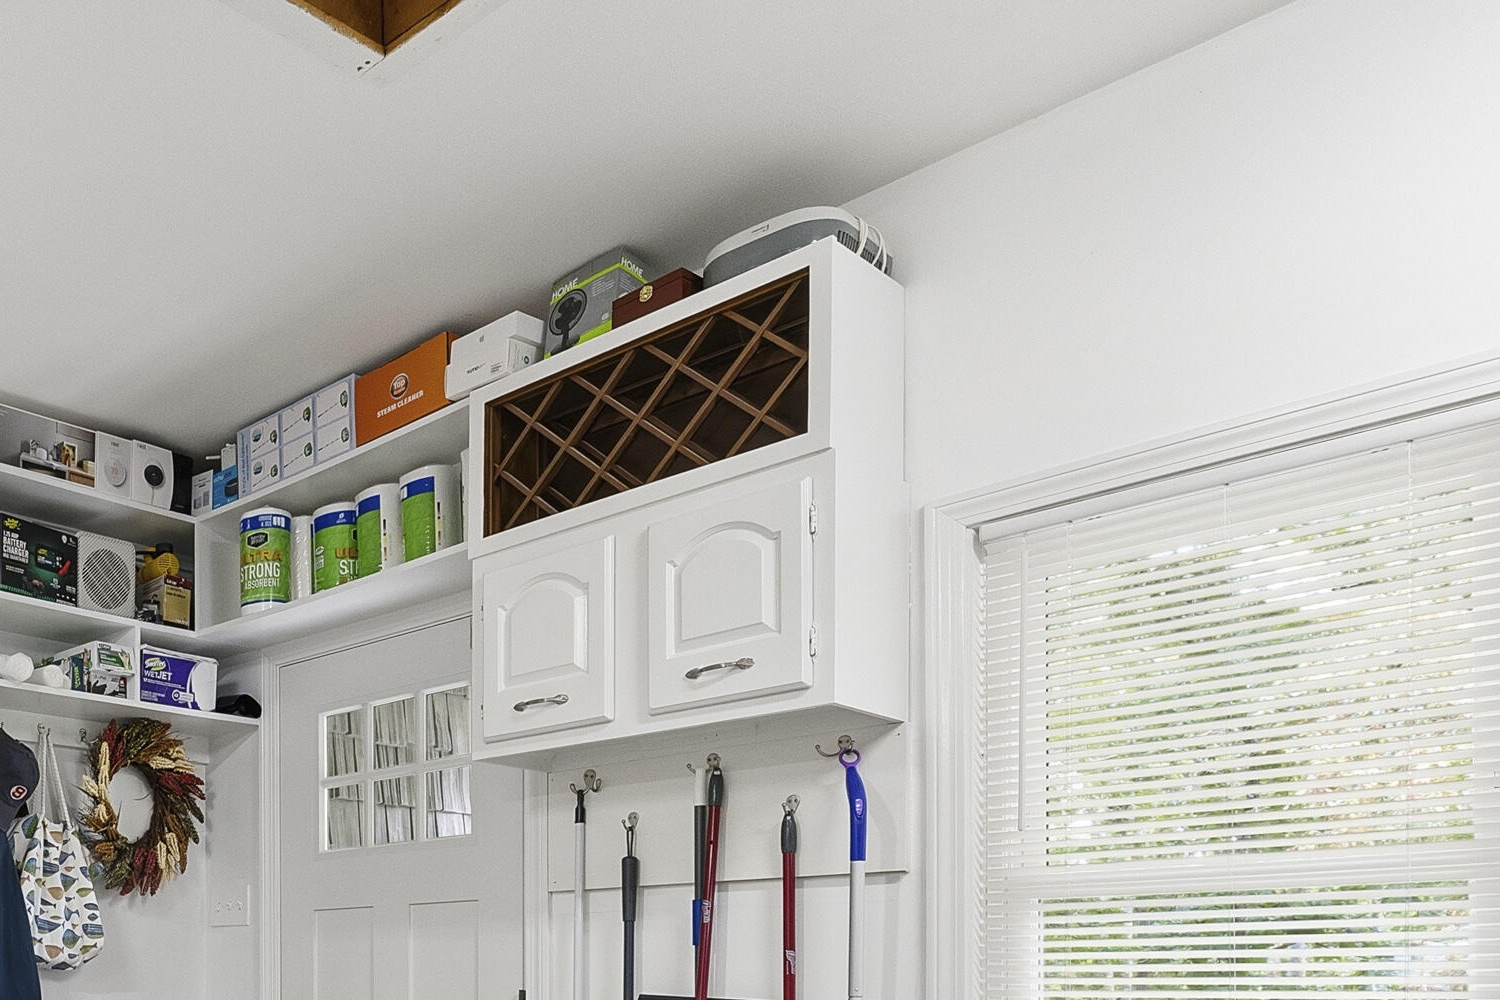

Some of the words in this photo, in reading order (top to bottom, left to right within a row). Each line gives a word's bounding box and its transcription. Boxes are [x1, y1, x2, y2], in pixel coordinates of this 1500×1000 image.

[621, 257, 644, 278] HOME
[552, 278, 579, 300] HOME
[376, 402, 397, 418] STEAM
[397, 389, 424, 409] CLEANER
[2, 536, 27, 550] BATTERY
[2, 544, 29, 559] CHARGER
[240, 562, 280, 582] STRONG
[244, 577, 280, 590] ABSORBENT
[143, 670, 172, 681] WETJET
